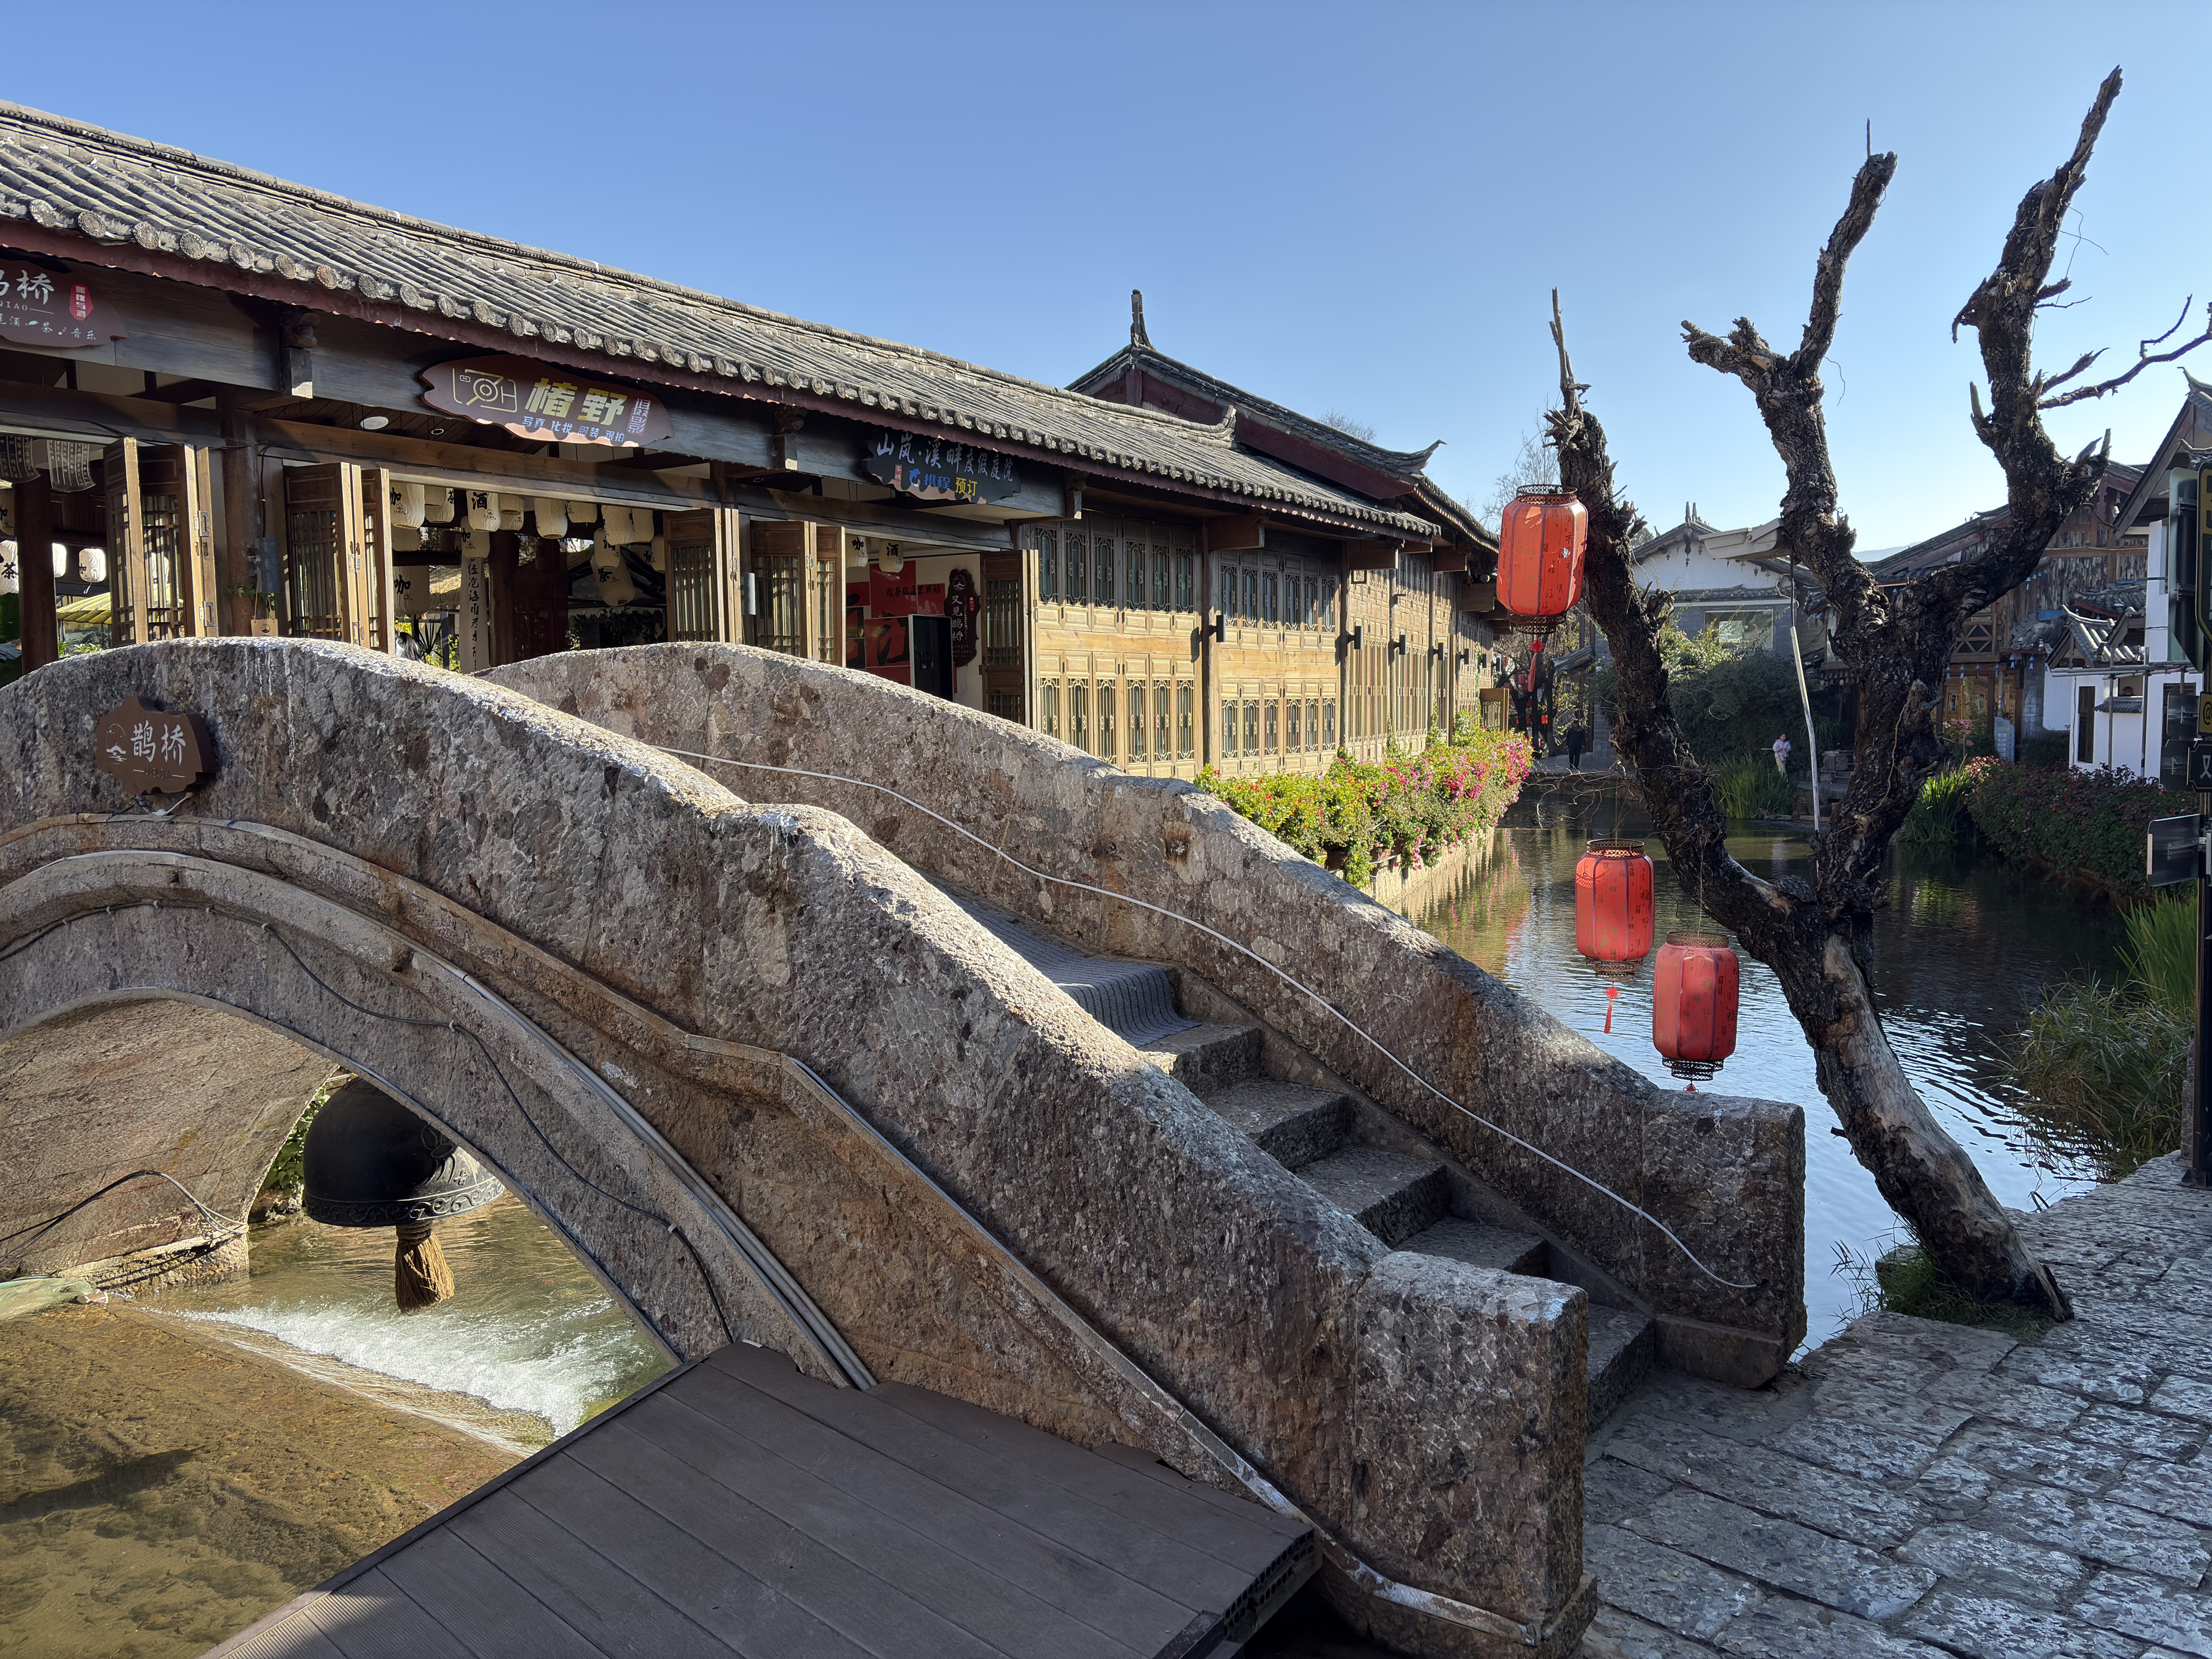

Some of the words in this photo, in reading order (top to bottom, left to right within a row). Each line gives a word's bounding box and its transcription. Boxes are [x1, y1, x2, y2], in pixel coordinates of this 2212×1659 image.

[40, 321, 53, 333] 茶
[71, 327, 96, 341] 音乐
[627, 398, 651, 434] 摄影
[521, 415, 546, 429] 写真
[550, 420, 573, 434] 化妆
[577, 425, 600, 439] 服装
[603, 430, 625, 442] 跟拍
[924, 473, 951, 490] 携程
[955, 477, 978, 496] 预订
[471, 492, 488, 510] 酒
[851, 538, 864, 551] 咖
[886, 542, 899, 557] 酒
[1, 562, 19, 580] 茶
[394, 574, 411, 594] 咖
[951, 595, 963, 642] 又见鹊桥
[129, 719, 187, 767] 鹊桥
